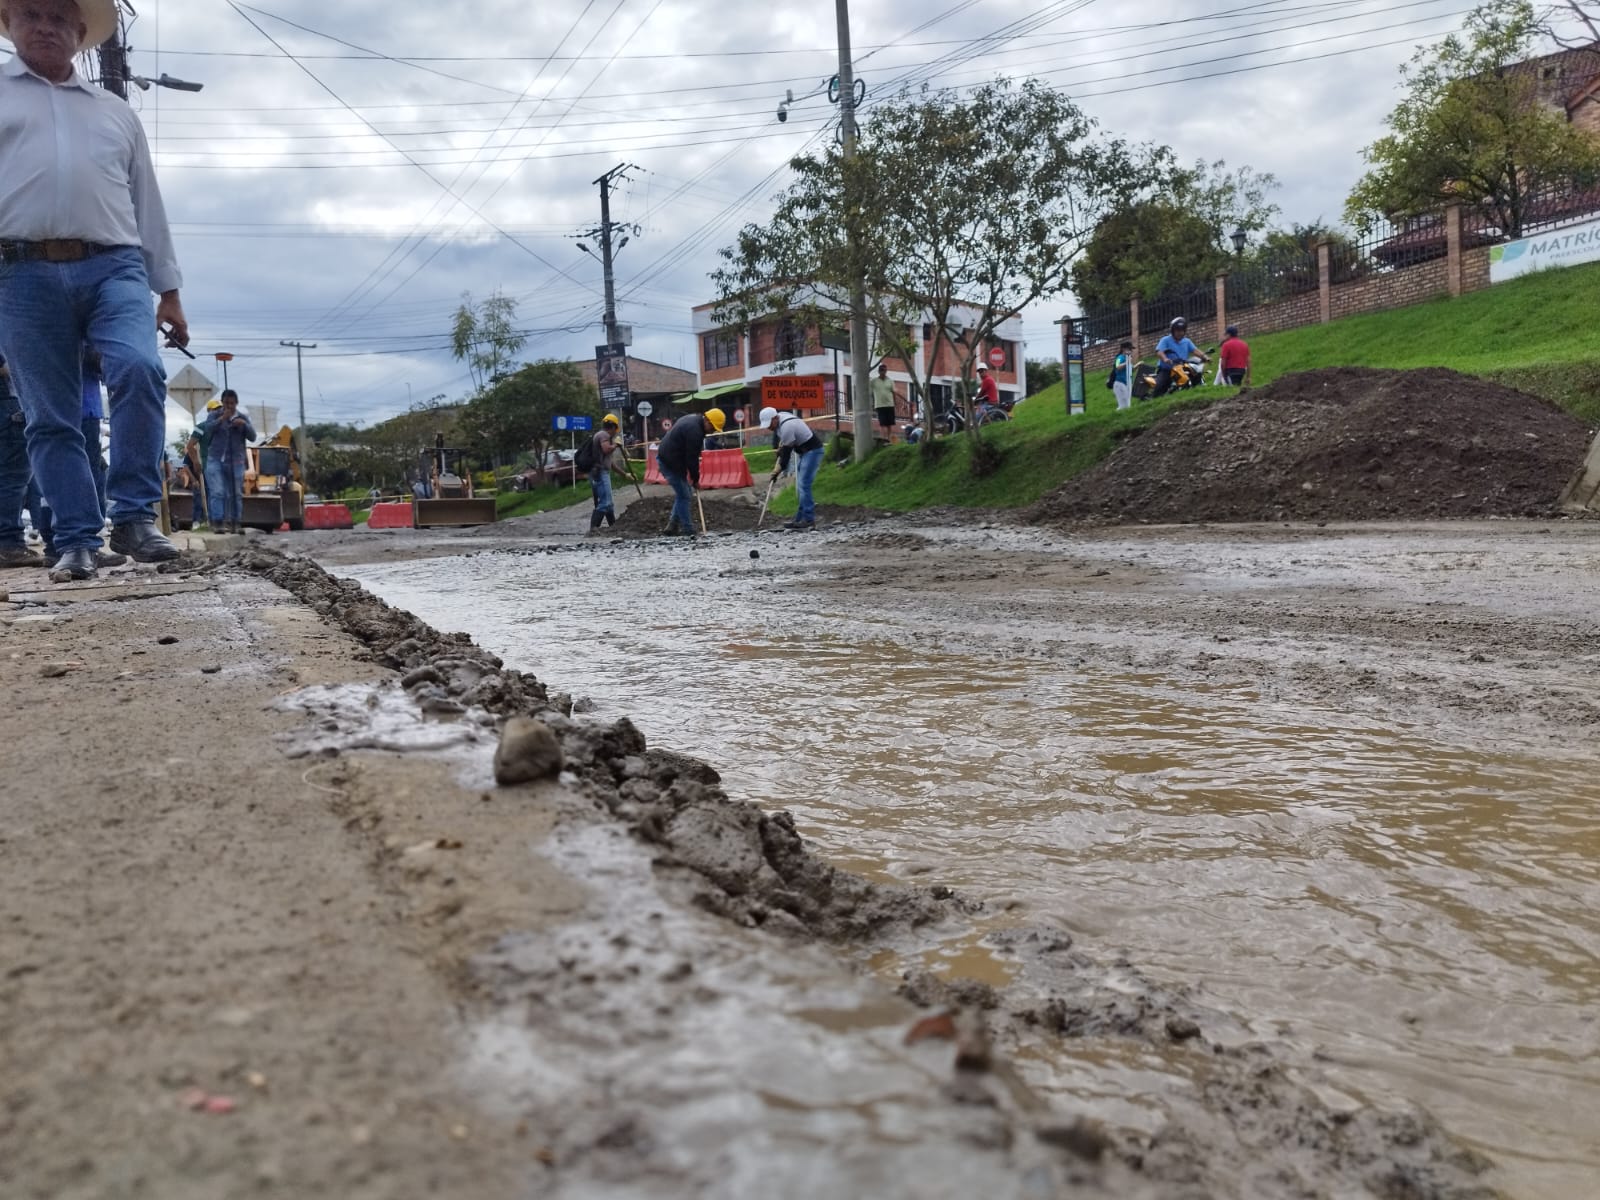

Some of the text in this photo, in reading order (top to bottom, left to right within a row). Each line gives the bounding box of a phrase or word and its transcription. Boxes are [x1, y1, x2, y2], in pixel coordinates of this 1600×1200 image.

[765, 379, 792, 387] ENTRADA
[800, 379, 820, 387] SALIDA
[767, 389, 818, 400] DE VOLQUETAS
